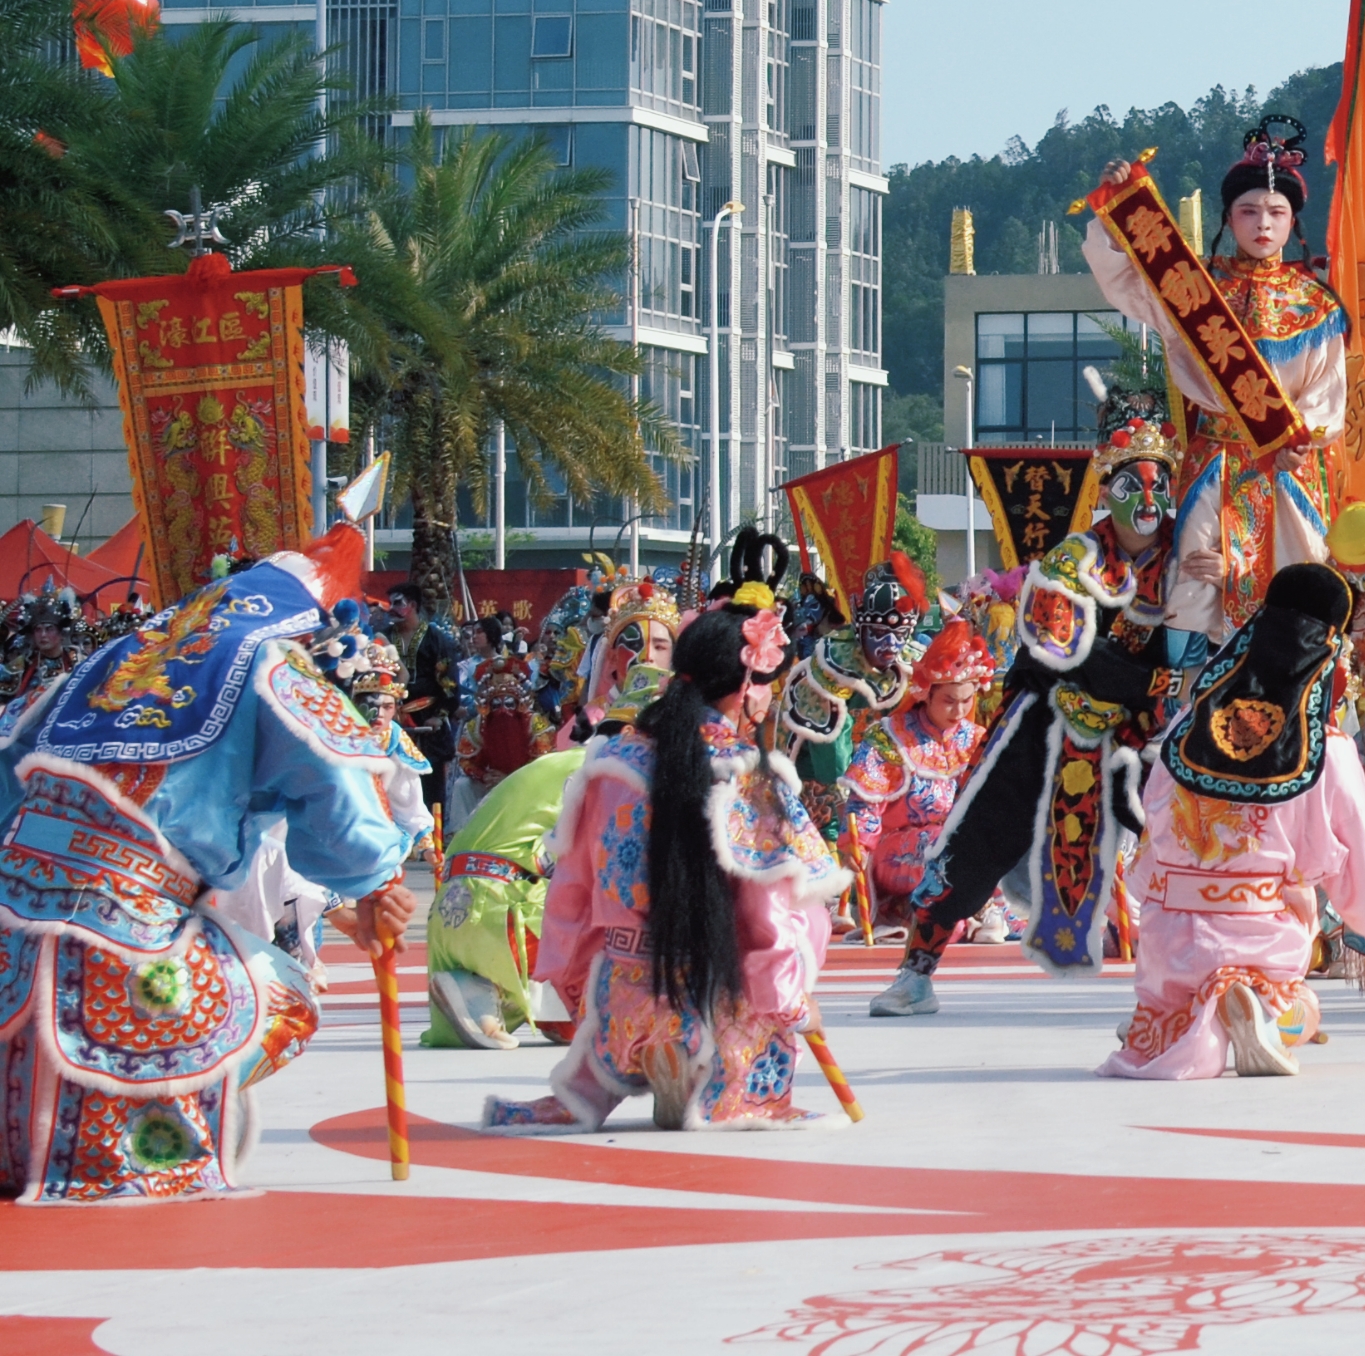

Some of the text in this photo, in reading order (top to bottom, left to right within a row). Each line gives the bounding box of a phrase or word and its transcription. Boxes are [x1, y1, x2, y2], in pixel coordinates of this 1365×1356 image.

[159, 310, 248, 350] 濠江區
[1125, 204, 1286, 423] 舞動英歌
